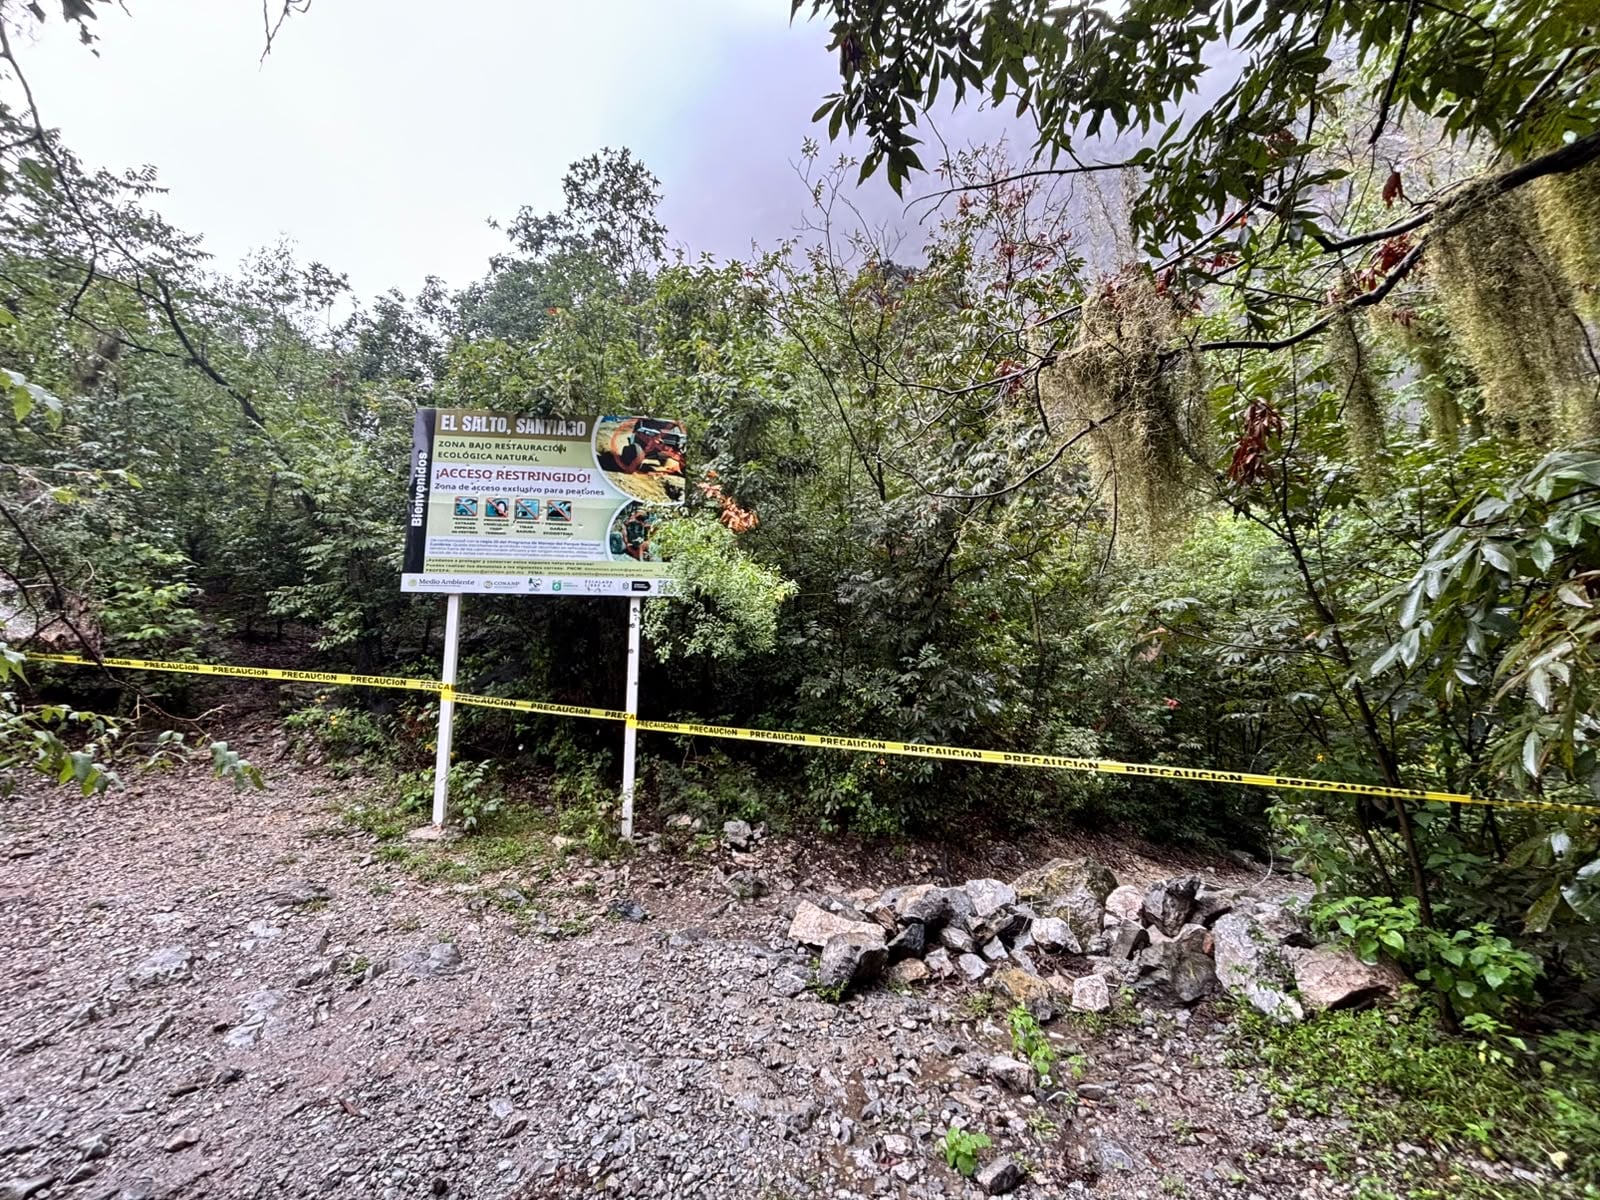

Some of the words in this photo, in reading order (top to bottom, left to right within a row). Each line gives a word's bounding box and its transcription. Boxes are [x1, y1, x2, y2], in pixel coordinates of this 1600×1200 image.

[440, 414, 458, 431] EL
[462, 416, 512, 435] SALTO,
[516, 417, 587, 437] SANTIAGO
[438, 440, 466, 448] ZONA
[468, 441, 492, 450] BAJO
[494, 442, 567, 453] RESTAURACIÓN
[438, 450, 493, 460] ECOLÓGICA
[495, 453, 540, 462] NATURAL
[496, 469, 591, 483] RESTRINGIDO!
[411, 451, 428, 527] Bienvenidos
[434, 482, 457, 491] Zona
[459, 483, 470, 491] de
[471, 484, 500, 492] acceso
[502, 485, 542, 494] exclusivo
[544, 487, 564, 496] para
[419, 578, 440, 586] Medio
[442, 579, 476, 588] Ambiente
